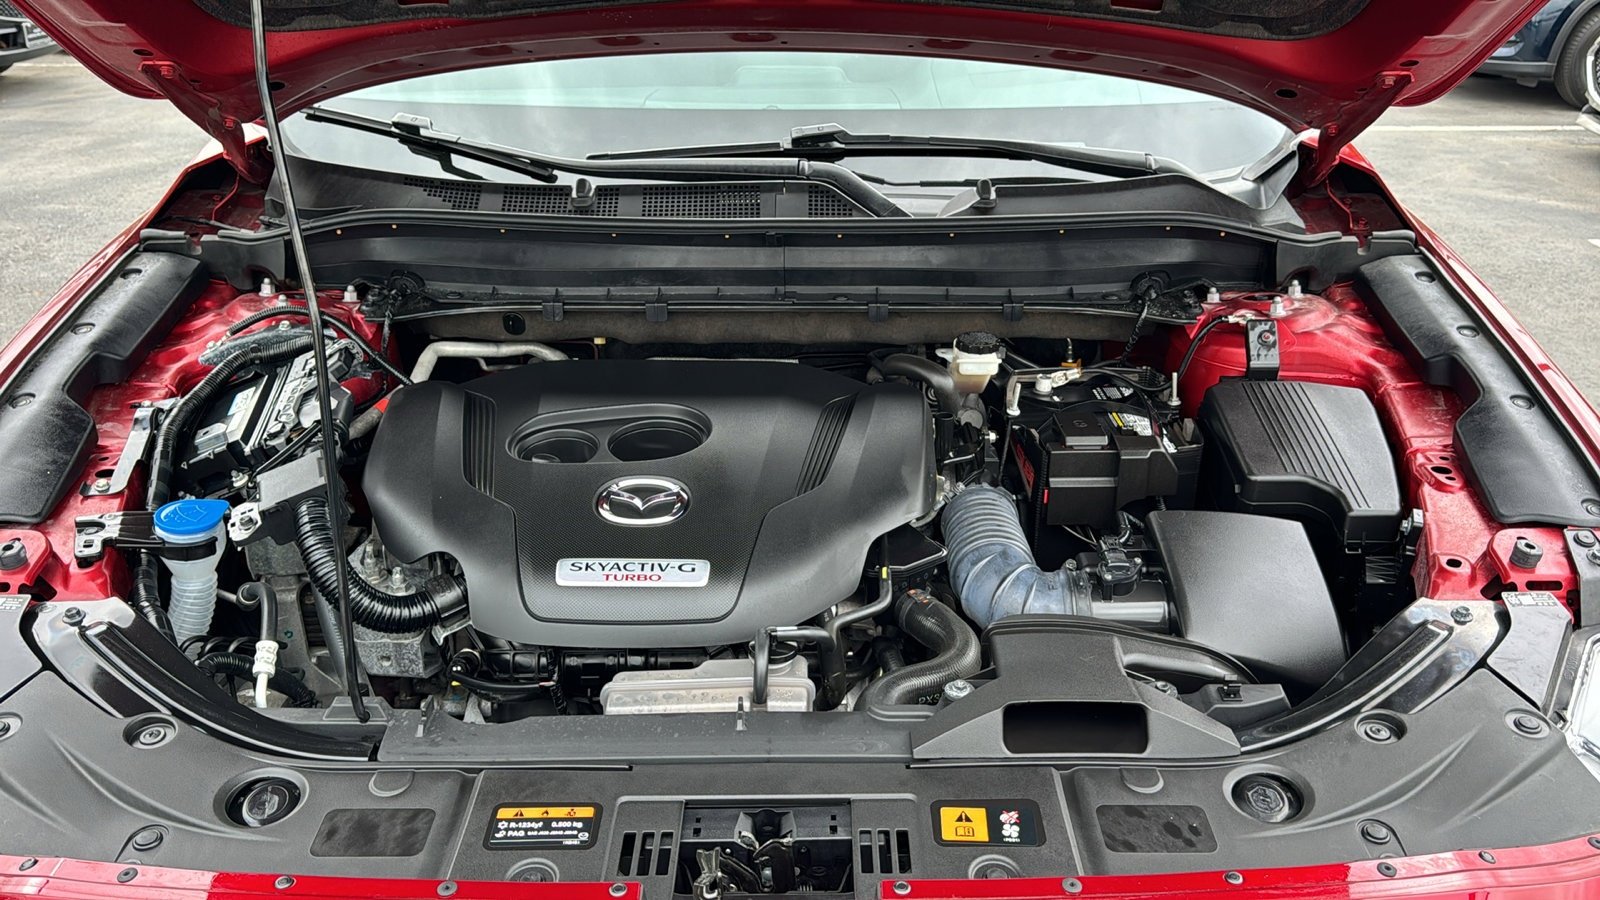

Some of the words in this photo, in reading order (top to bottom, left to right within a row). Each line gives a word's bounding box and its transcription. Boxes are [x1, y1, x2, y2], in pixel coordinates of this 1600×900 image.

[569, 561, 697, 573] SKYACTIV-G
[602, 573, 662, 582] TURBO
[509, 821, 543, 829] R-1234yf
